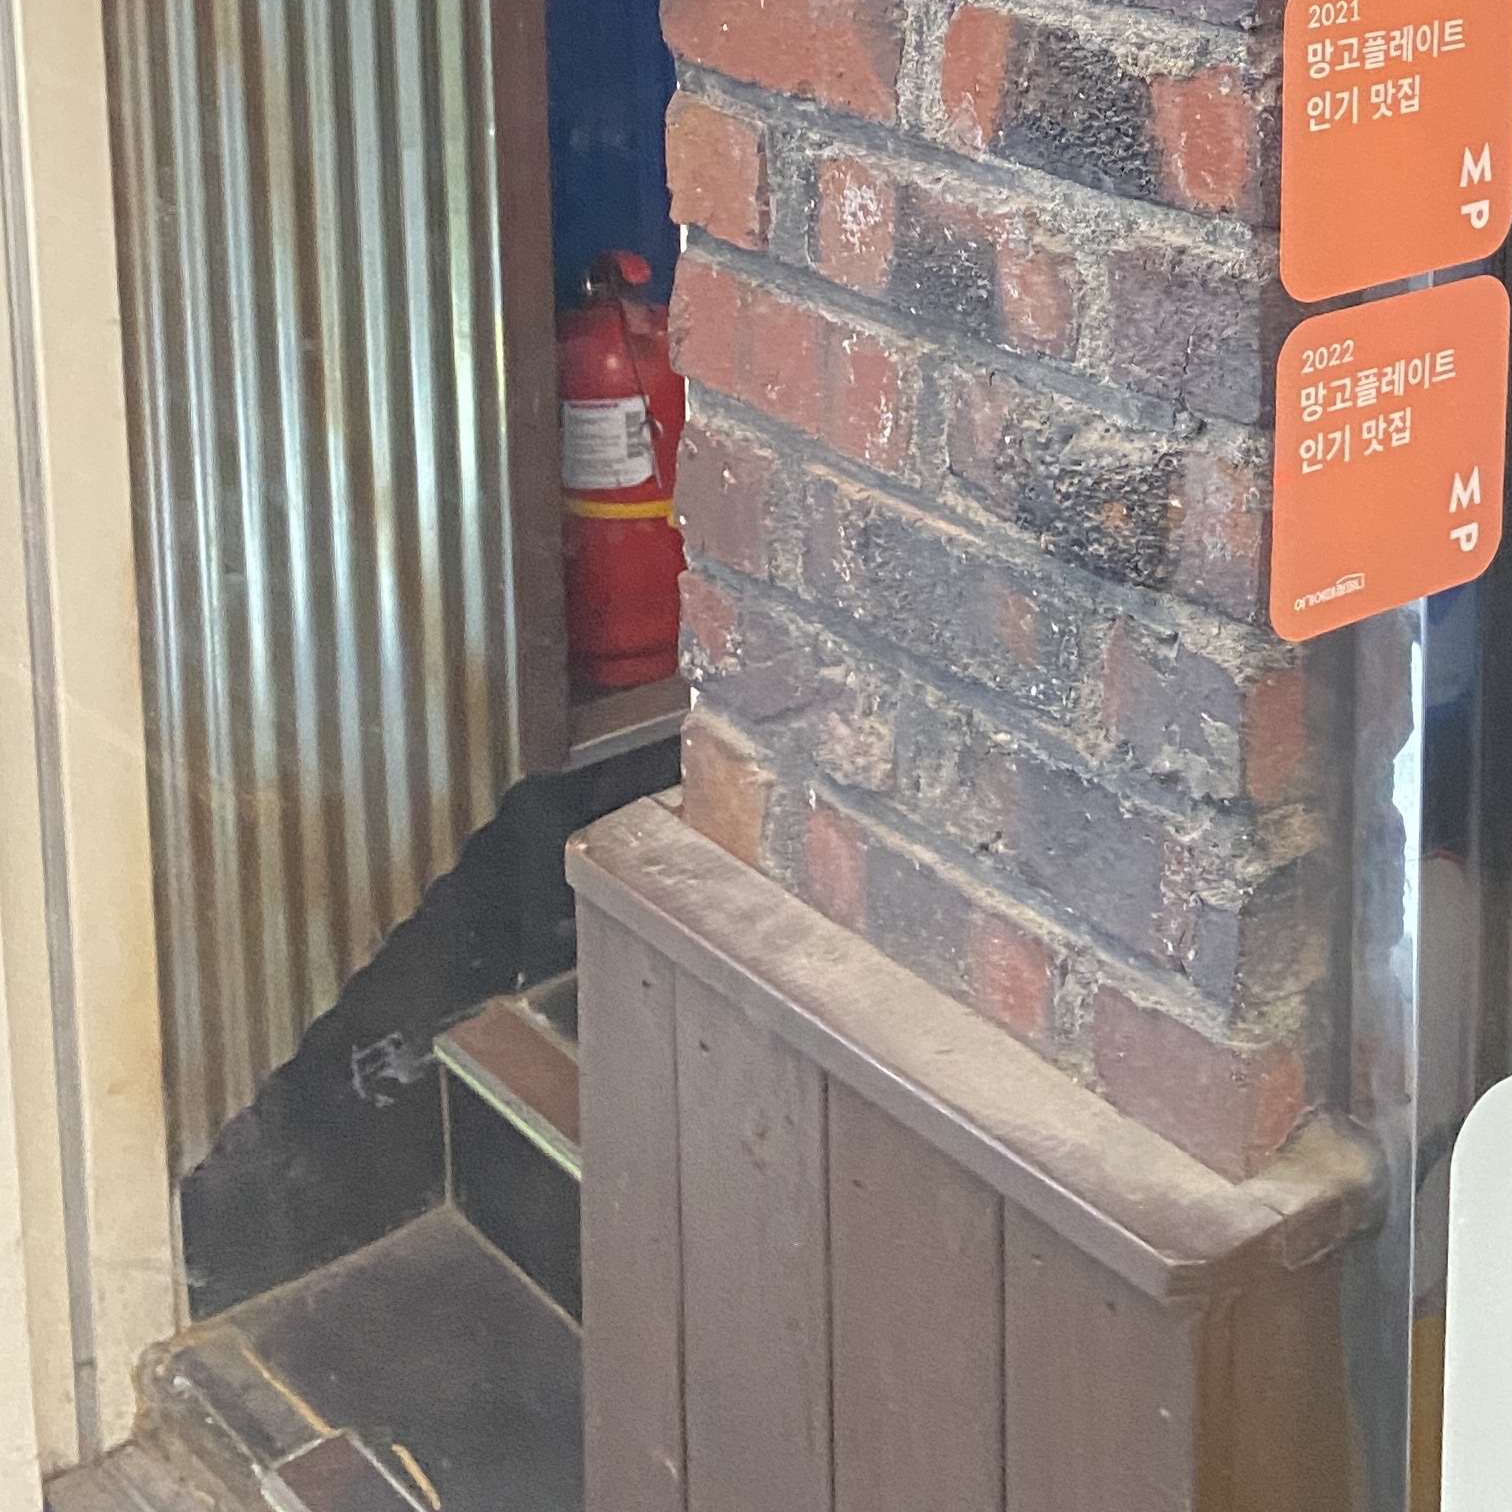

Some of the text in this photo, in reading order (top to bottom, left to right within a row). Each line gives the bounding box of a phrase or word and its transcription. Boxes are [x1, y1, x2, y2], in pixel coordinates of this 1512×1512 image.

[1307, 19, 1466, 80] 망고플레이트
[1306, 74, 1421, 133] 인기 맛집
[1300, 348, 1456, 422] 망고플레이트
[1301, 339, 1354, 374] 2022
[1299, 407, 1412, 474] 인기 맛집
